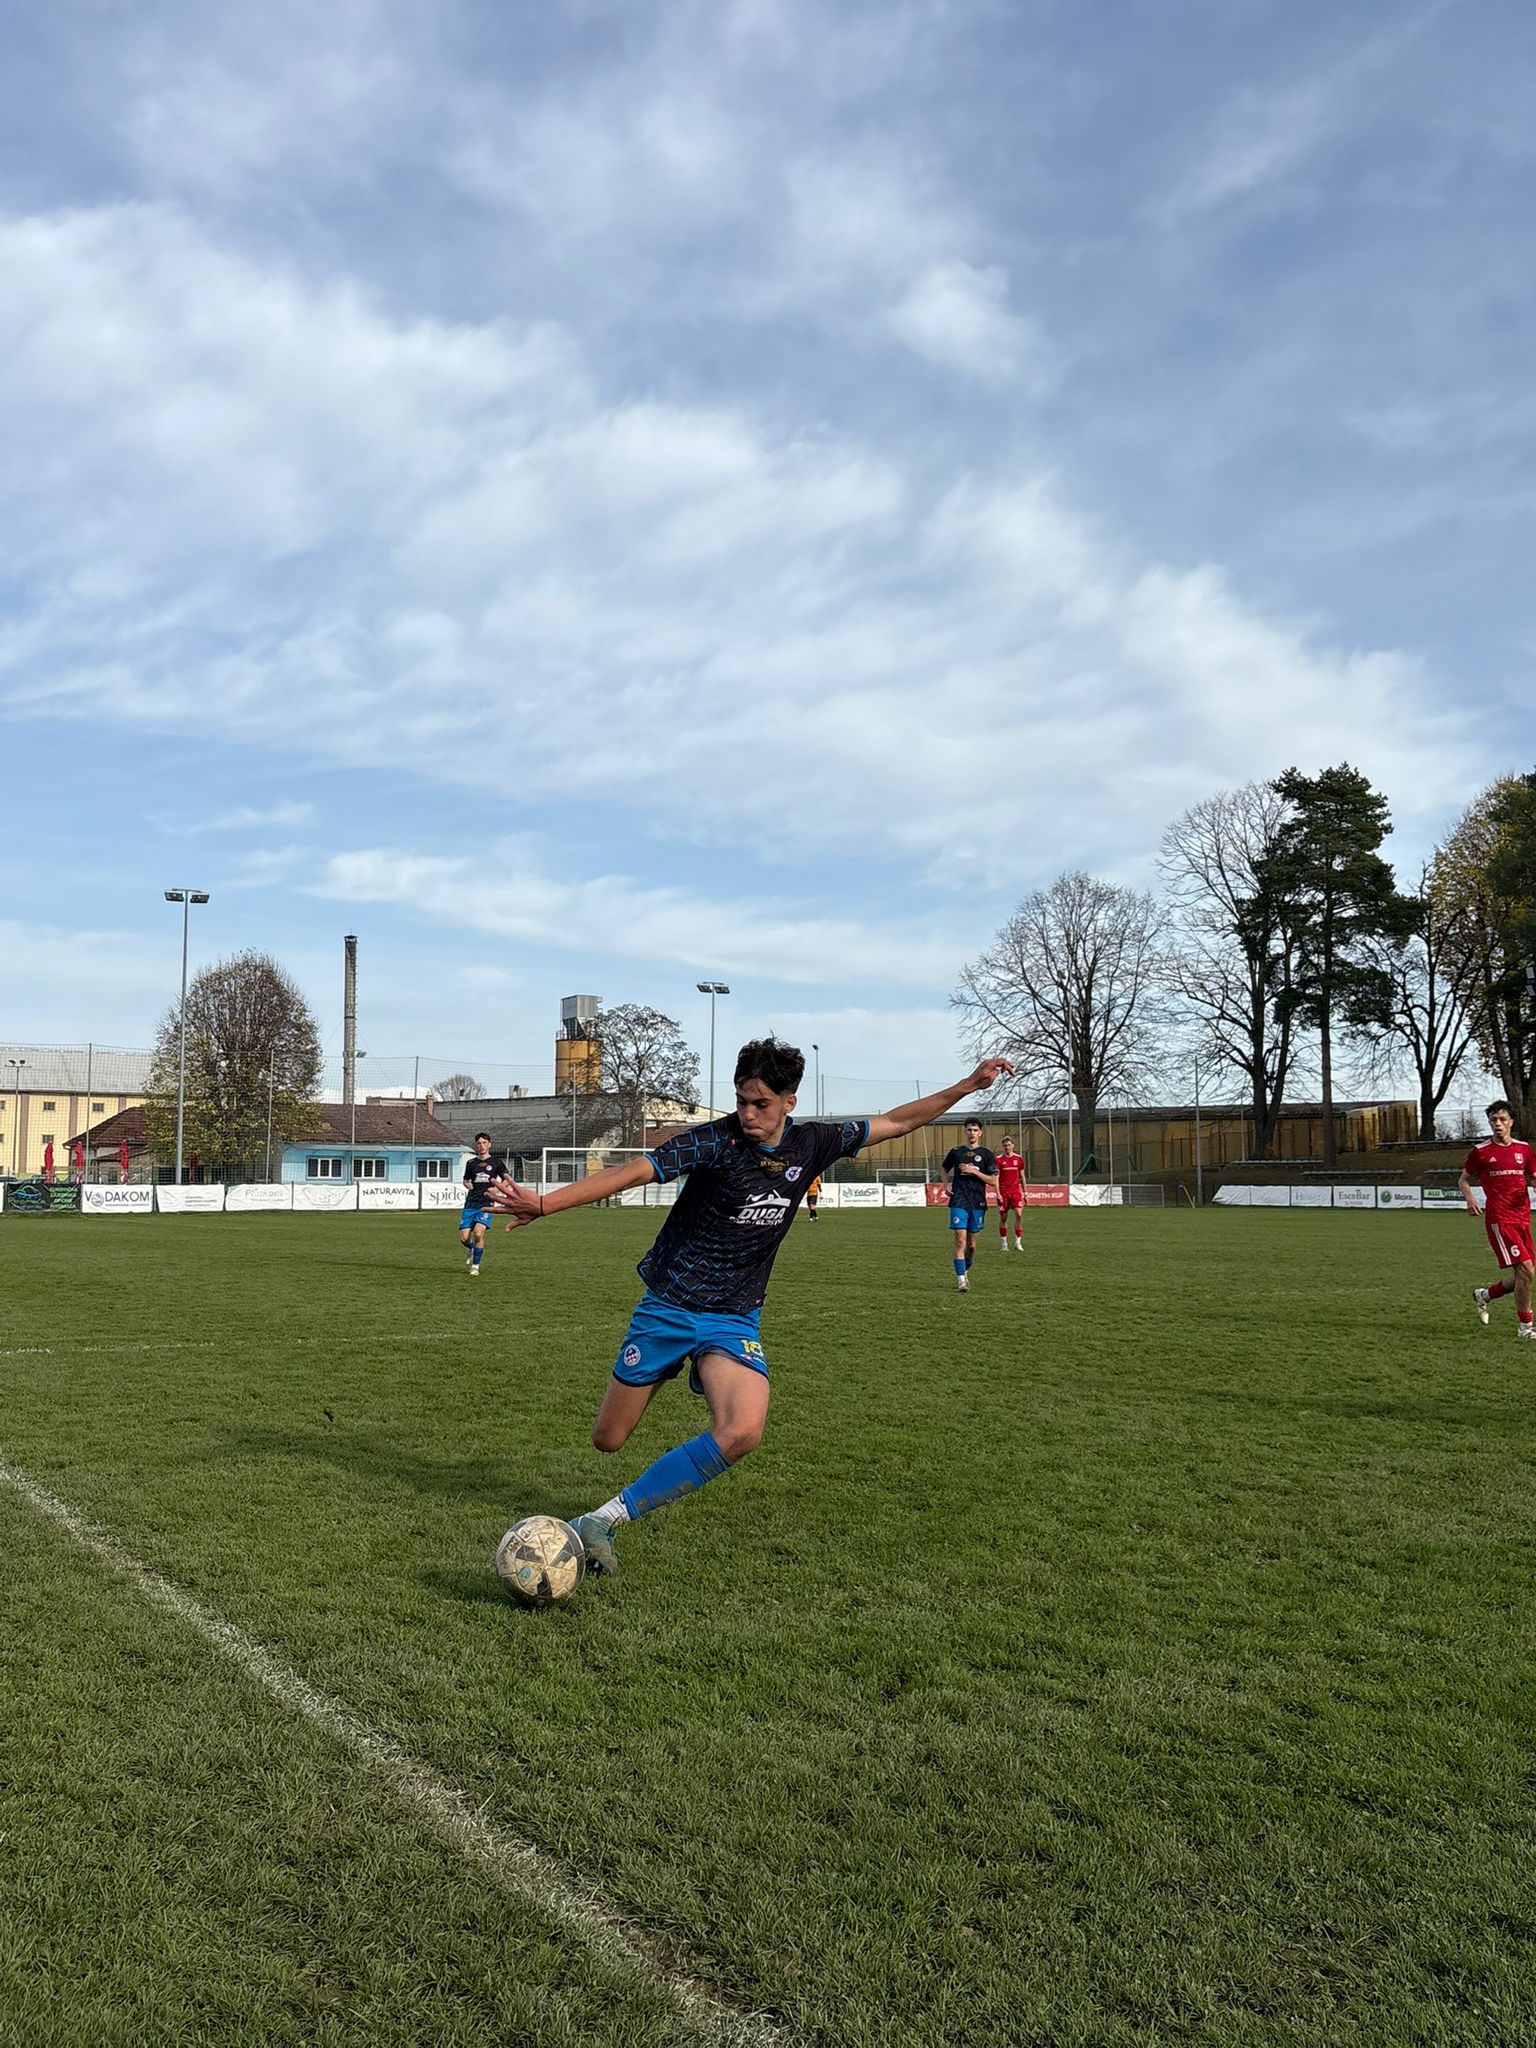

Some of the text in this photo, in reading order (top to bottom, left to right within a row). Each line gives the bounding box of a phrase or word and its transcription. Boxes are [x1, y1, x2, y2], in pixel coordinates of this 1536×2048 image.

[362, 1187, 415, 1196] NATURAVITA
[738, 1207, 786, 1220] DUGA
[1510, 1244, 1520, 1257] 6
